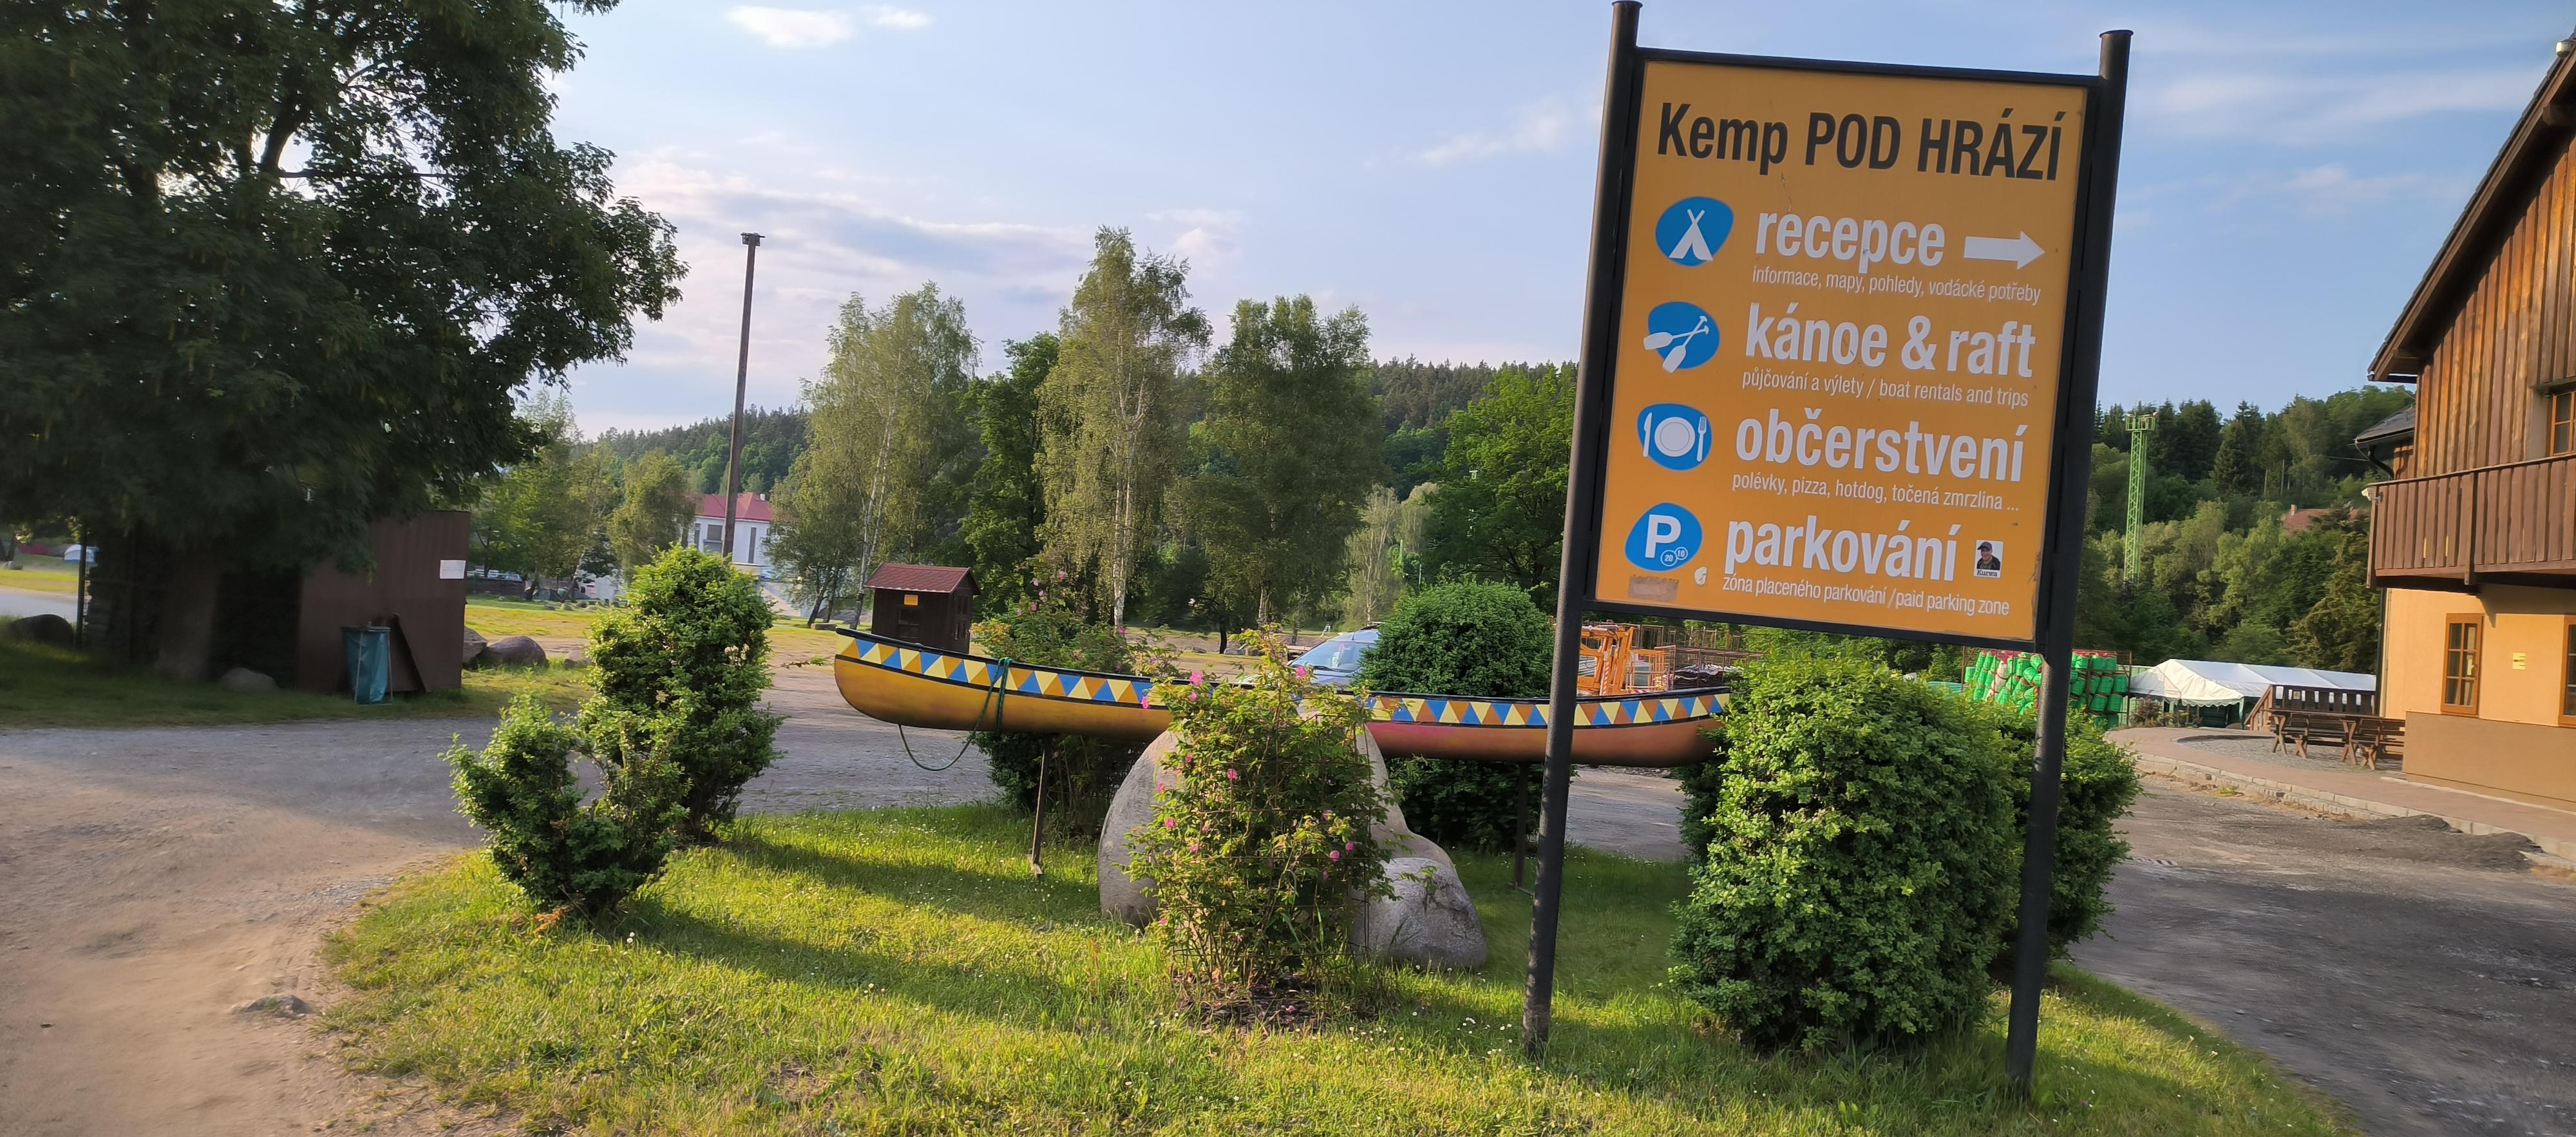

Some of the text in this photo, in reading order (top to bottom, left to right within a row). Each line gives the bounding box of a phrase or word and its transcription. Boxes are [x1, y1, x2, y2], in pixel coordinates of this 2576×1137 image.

[1658, 102, 2066, 181] Kemp POD HRÁZÍ
[1756, 211, 1946, 274] recepce
[1752, 266, 2041, 306] informace, mapy, pohledy, vodácké potřeby
[1745, 301, 2036, 379] kánoe & raft
[1742, 367, 1809, 390] půjčování
[1812, 377, 1820, 391] a
[1824, 375, 1864, 398] výlety
[1880, 378, 1911, 398] boat
[1915, 384, 1963, 401] rentals
[1967, 387, 1994, 405] and
[1998, 388, 2029, 409] trips
[1736, 407, 2027, 481] občerstvení
[1732, 472, 1788, 495] polévky,
[1792, 476, 1831, 499] pizza,
[1835, 479, 1888, 504] hotdog,
[1893, 484, 1940, 505] točená
[1645, 514, 1681, 559] P
[1724, 515, 1962, 582] parkování
[1723, 573, 1752, 592] zóna
[1756, 577, 1821, 598] placeného
[1824, 584, 1887, 604] parkování
[1927, 593, 1976, 616] parking
[1978, 599, 2010, 616] zone
